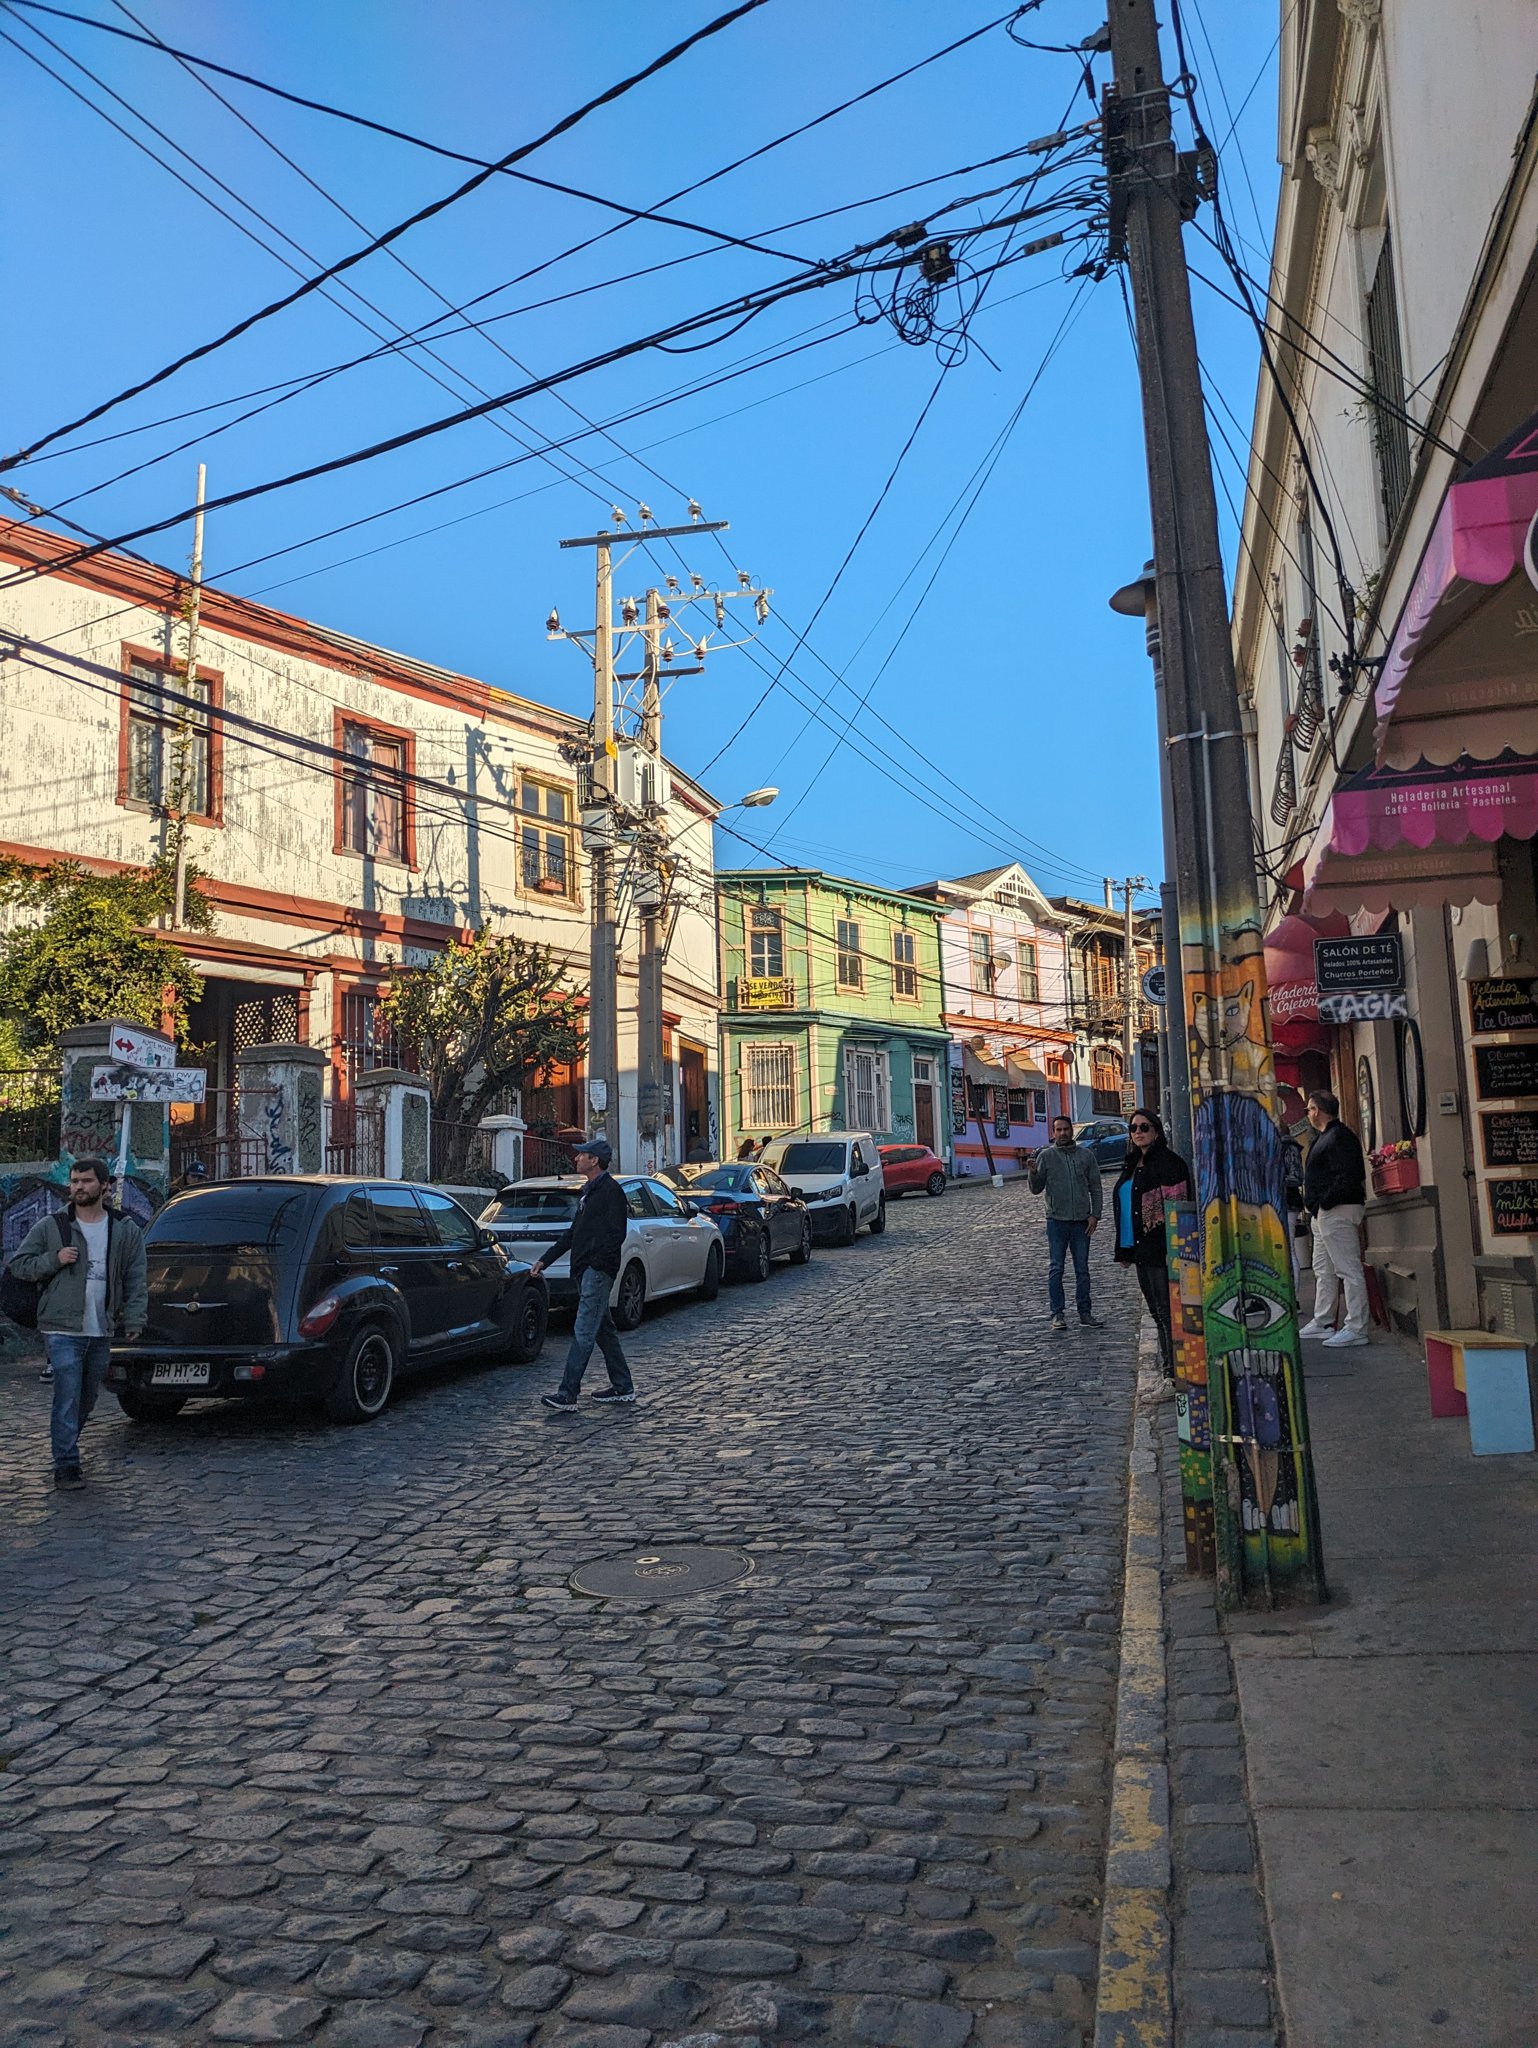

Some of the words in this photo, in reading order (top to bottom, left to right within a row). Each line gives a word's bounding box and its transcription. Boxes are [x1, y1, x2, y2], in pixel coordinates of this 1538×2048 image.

[1452, 782, 1510, 797] Artesanal
[1385, 805, 1408, 815] Café
[1472, 795, 1517, 807] Pasteles
[1322, 945, 1359, 958] SALÓN
[1362, 946, 1377, 955] DE
[1380, 942, 1392, 953] TÉ
[1362, 957, 1393, 966] Artesanales
[1324, 970, 1356, 979] Churros
[1358, 968, 1394, 976] Porteños
[750, 982, 758, 990] SE
[1472, 980, 1517, 996] Helados
[1476, 1012, 1496, 1029] Ice
[1496, 1195, 1532, 1210] milk
